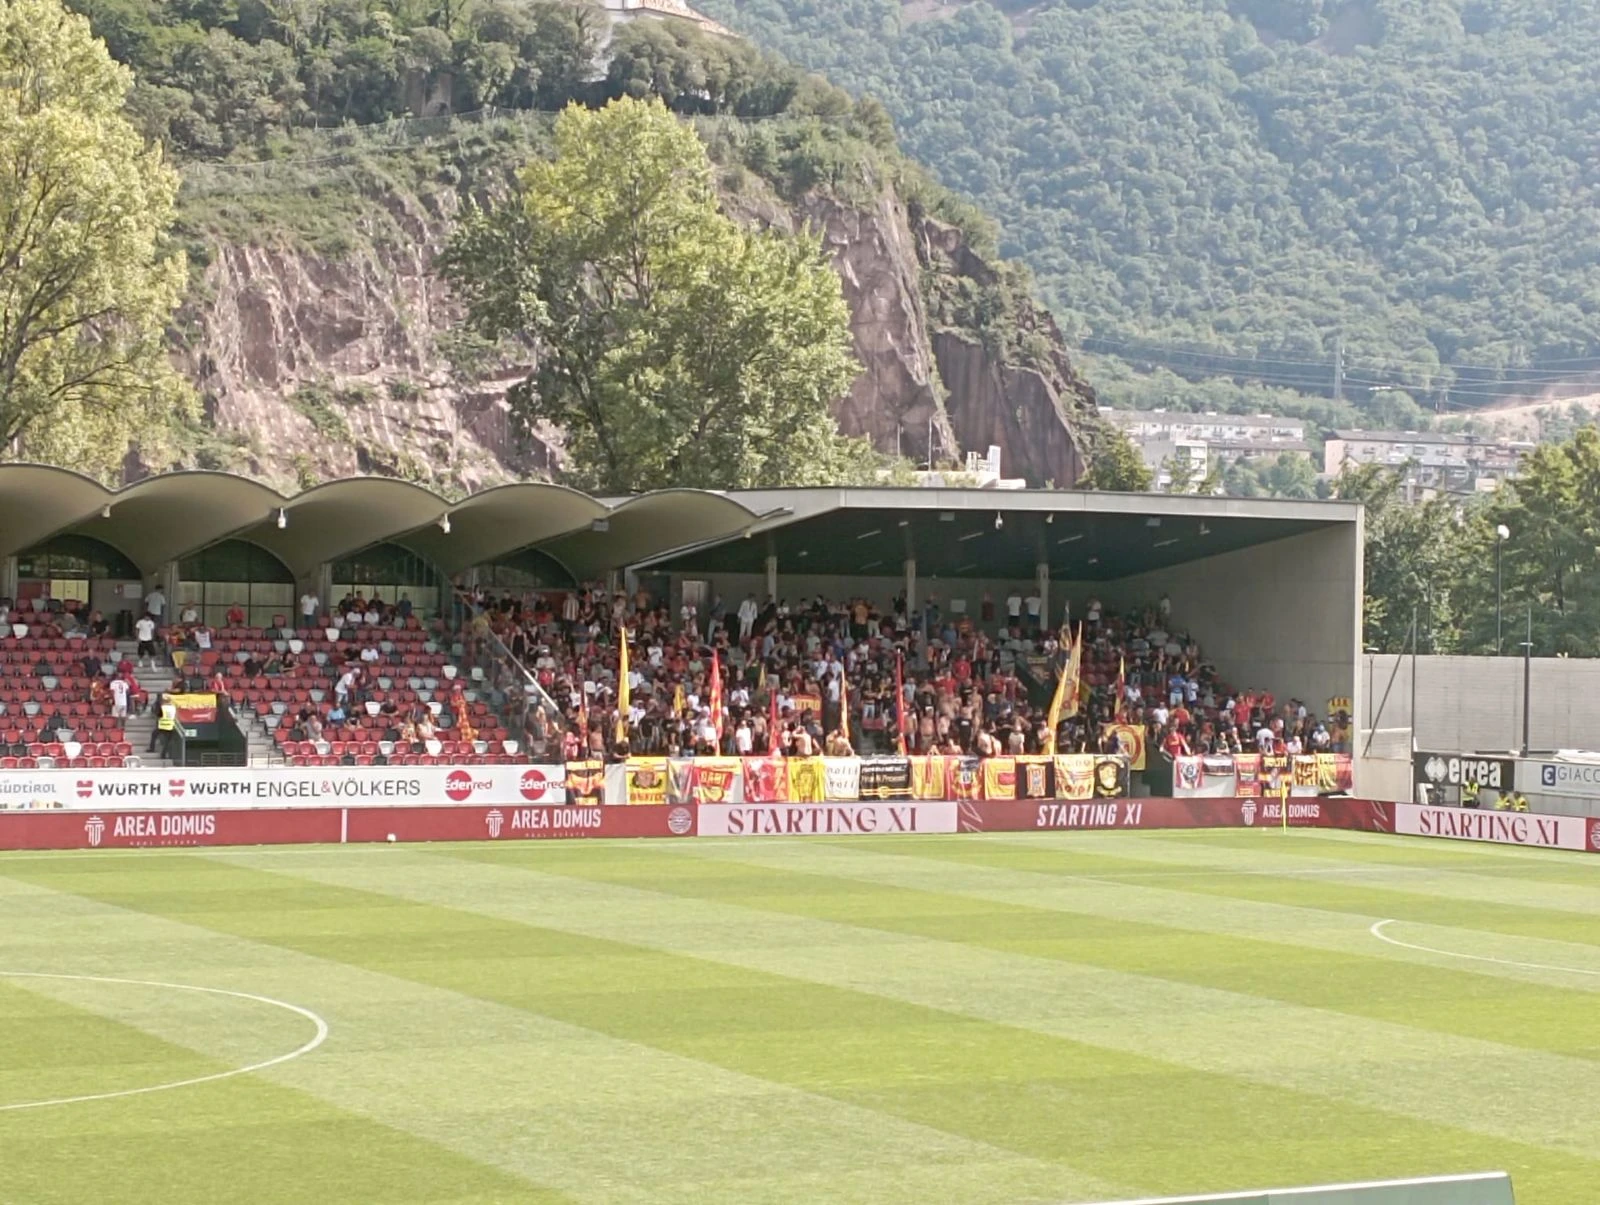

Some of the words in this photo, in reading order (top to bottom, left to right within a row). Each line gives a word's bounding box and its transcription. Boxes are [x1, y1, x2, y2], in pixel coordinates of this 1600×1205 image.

[98, 782, 161, 796] WÜRTH
[190, 781, 251, 796] WÜRTH
[256, 778, 421, 798] ENGEL&VÖLKERS
[445, 779, 493, 790] Edenred
[511, 809, 549, 829] AREA
[553, 809, 601, 828] DOMUS
[727, 807, 878, 835] STARTING
[888, 807, 917, 832] XI
[1037, 804, 1117, 827] STARTING
[1123, 804, 1142, 825] XI
[1262, 805, 1286, 818] AREA
[1288, 804, 1320, 818] DOMUS
[114, 815, 156, 837] AREA
[161, 814, 216, 836] DOMUS
[1420, 809, 1528, 842] STARTING
[1536, 818, 1559, 846] XI
